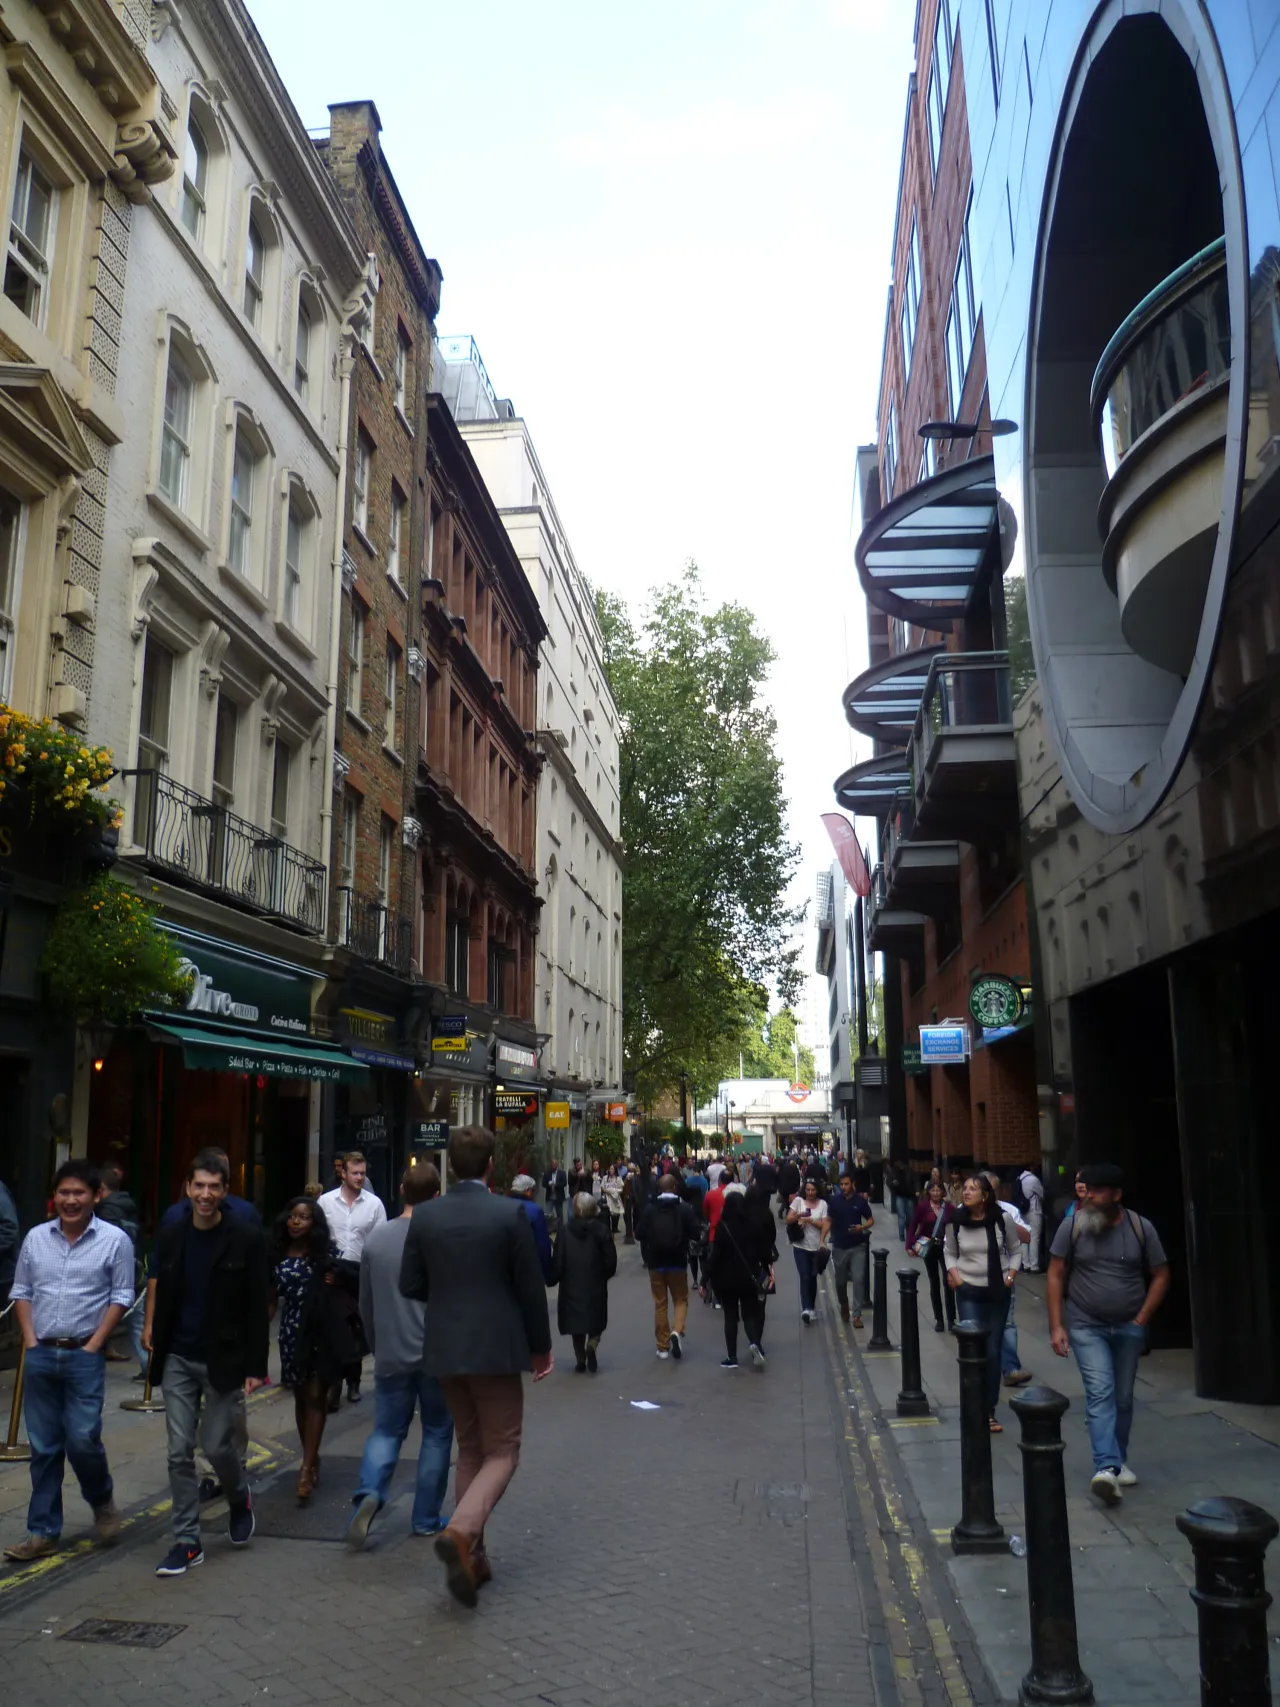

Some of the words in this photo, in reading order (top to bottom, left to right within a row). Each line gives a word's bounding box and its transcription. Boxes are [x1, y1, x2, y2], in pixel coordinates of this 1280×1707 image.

[972, 982, 1014, 1002] STARBUCKS
[978, 1013, 1010, 1024] COFFEE
[348, 1015, 386, 1042] VILLIERS
[228, 1055, 244, 1068] Salad
[244, 1057, 255, 1069] Bar
[262, 1059, 275, 1071] Pizza
[549, 1111, 566, 1119] EAT.
[420, 1123, 441, 1132] BAR
